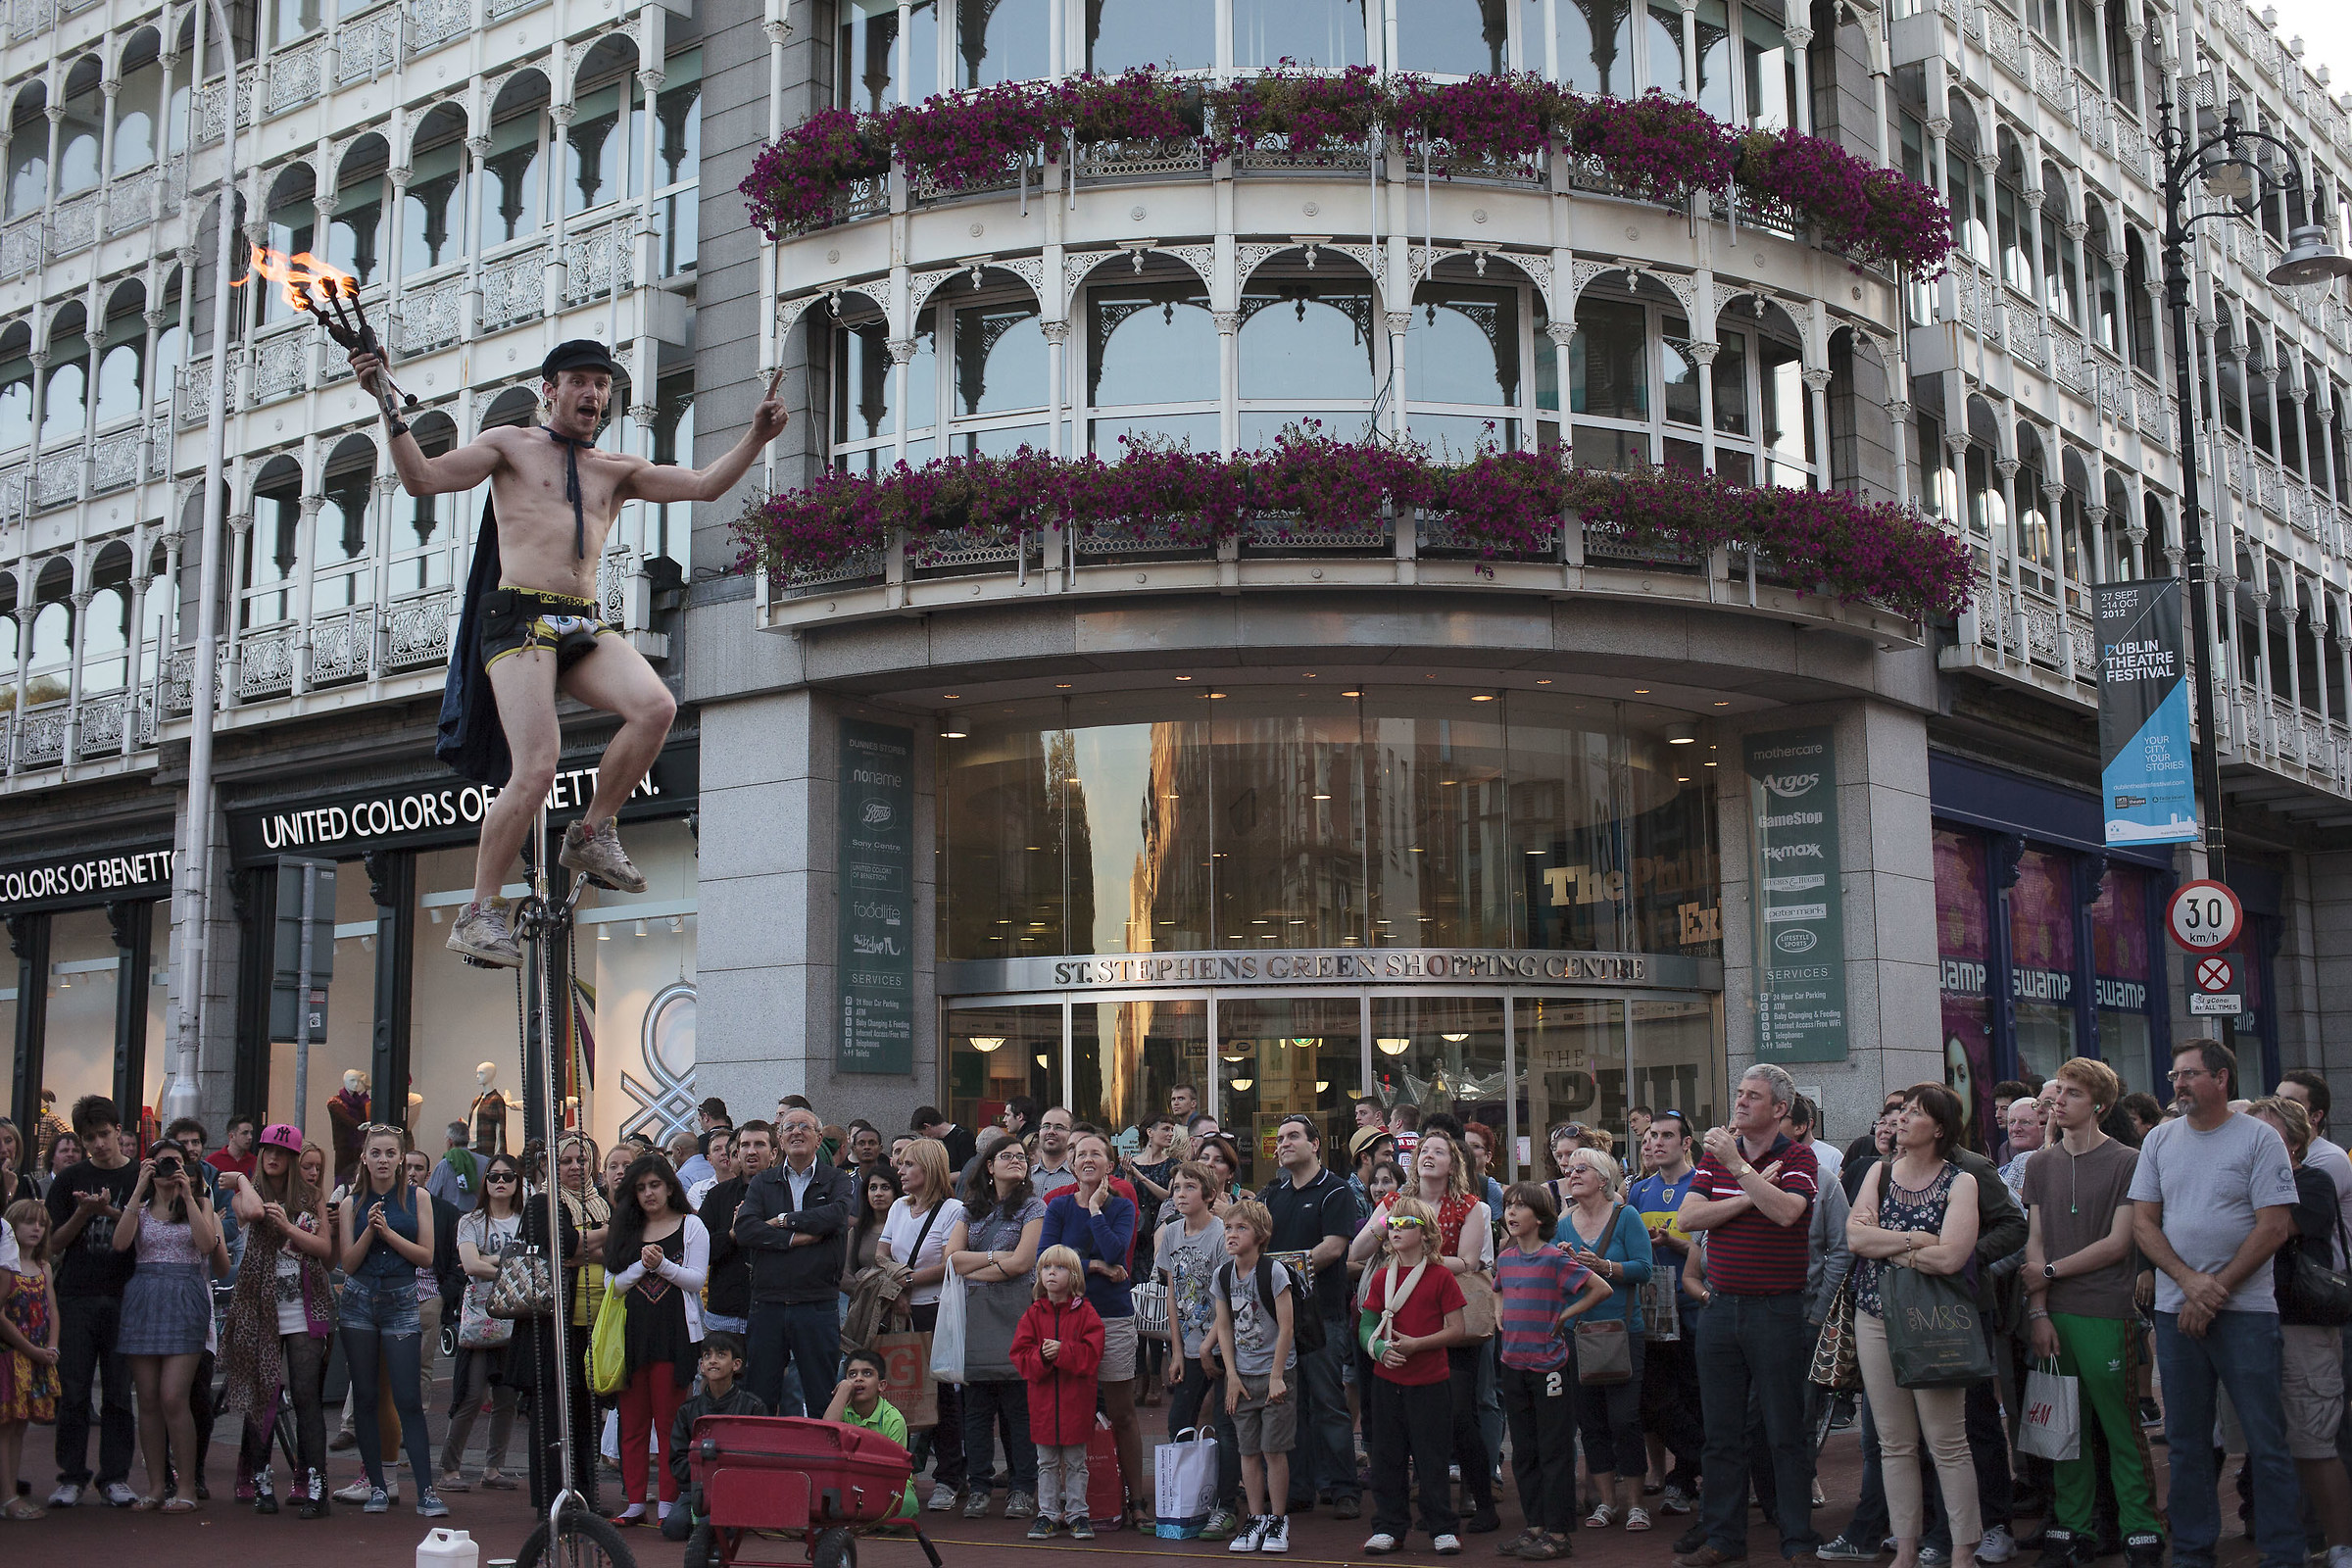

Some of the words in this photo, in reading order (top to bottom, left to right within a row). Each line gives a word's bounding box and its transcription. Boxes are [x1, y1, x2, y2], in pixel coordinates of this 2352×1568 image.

[2101, 593, 2112, 602] 27
[2114, 590, 2138, 600] SEPT
[2119, 599, 2138, 608] OCT
[2102, 609, 2127, 618] 2012
[2104, 639, 2159, 656] DUBLIN
[2106, 651, 2175, 669] THEATRE
[2106, 665, 2176, 683] FESTIVAL
[849, 738, 878, 752] DUNNES
[878, 744, 906, 756] STORES
[2144, 735, 2170, 745] YOUR
[1753, 743, 1823, 760] mothercare
[2145, 753, 2171, 762] YOUR
[2145, 760, 2184, 772] STORIES
[854, 769, 902, 788] noname
[1760, 772, 1820, 792] Argos
[262, 807, 348, 849] UNITED
[351, 790, 457, 837] COLORS
[460, 784, 495, 822] OF
[862, 803, 892, 823] Boots
[1758, 811, 1823, 828] GameStop
[852, 839, 872, 849] Sony
[873, 841, 902, 852] Centre
[71, 861, 98, 892] OF
[1544, 864, 1624, 906] The
[1798, 875, 1824, 884] HUGHES
[854, 901, 901, 919] foodlife
[2185, 899, 2223, 929] 30
[1678, 898, 1723, 945] Ex
[2189, 932, 2219, 943] km/h
[1054, 962, 1094, 984] ST.
[1098, 956, 1257, 983] STEPHENS
[1266, 955, 1376, 978] GREEN
[1386, 954, 1538, 978] SHOPPING
[1544, 956, 1646, 980] CENTRE
[1767, 967, 1829, 980] SERVICES
[852, 973, 902, 986] SERVICES
[2012, 968, 2072, 1002] swamp
[1805, 991, 1827, 1000] Parking
[2095, 979, 2146, 1009] swamp
[856, 1019, 866, 1028] Baby
[1788, 1010, 1813, 1020] Changing
[1819, 1009, 1841, 1018] Feeding
[1543, 1049, 1584, 1068] THE
[273, 1126, 291, 1143] NY
[1906, 1306, 1918, 1332] YOUR
[1915, 1304, 1972, 1331] M&S
[885, 1348, 916, 1387] G
[1546, 1371, 1563, 1396] 2
[2029, 1401, 2052, 1427] H&M
[2046, 1530, 2070, 1540] OSIRIS
[2128, 1535, 2157, 1545] OSIRIS
